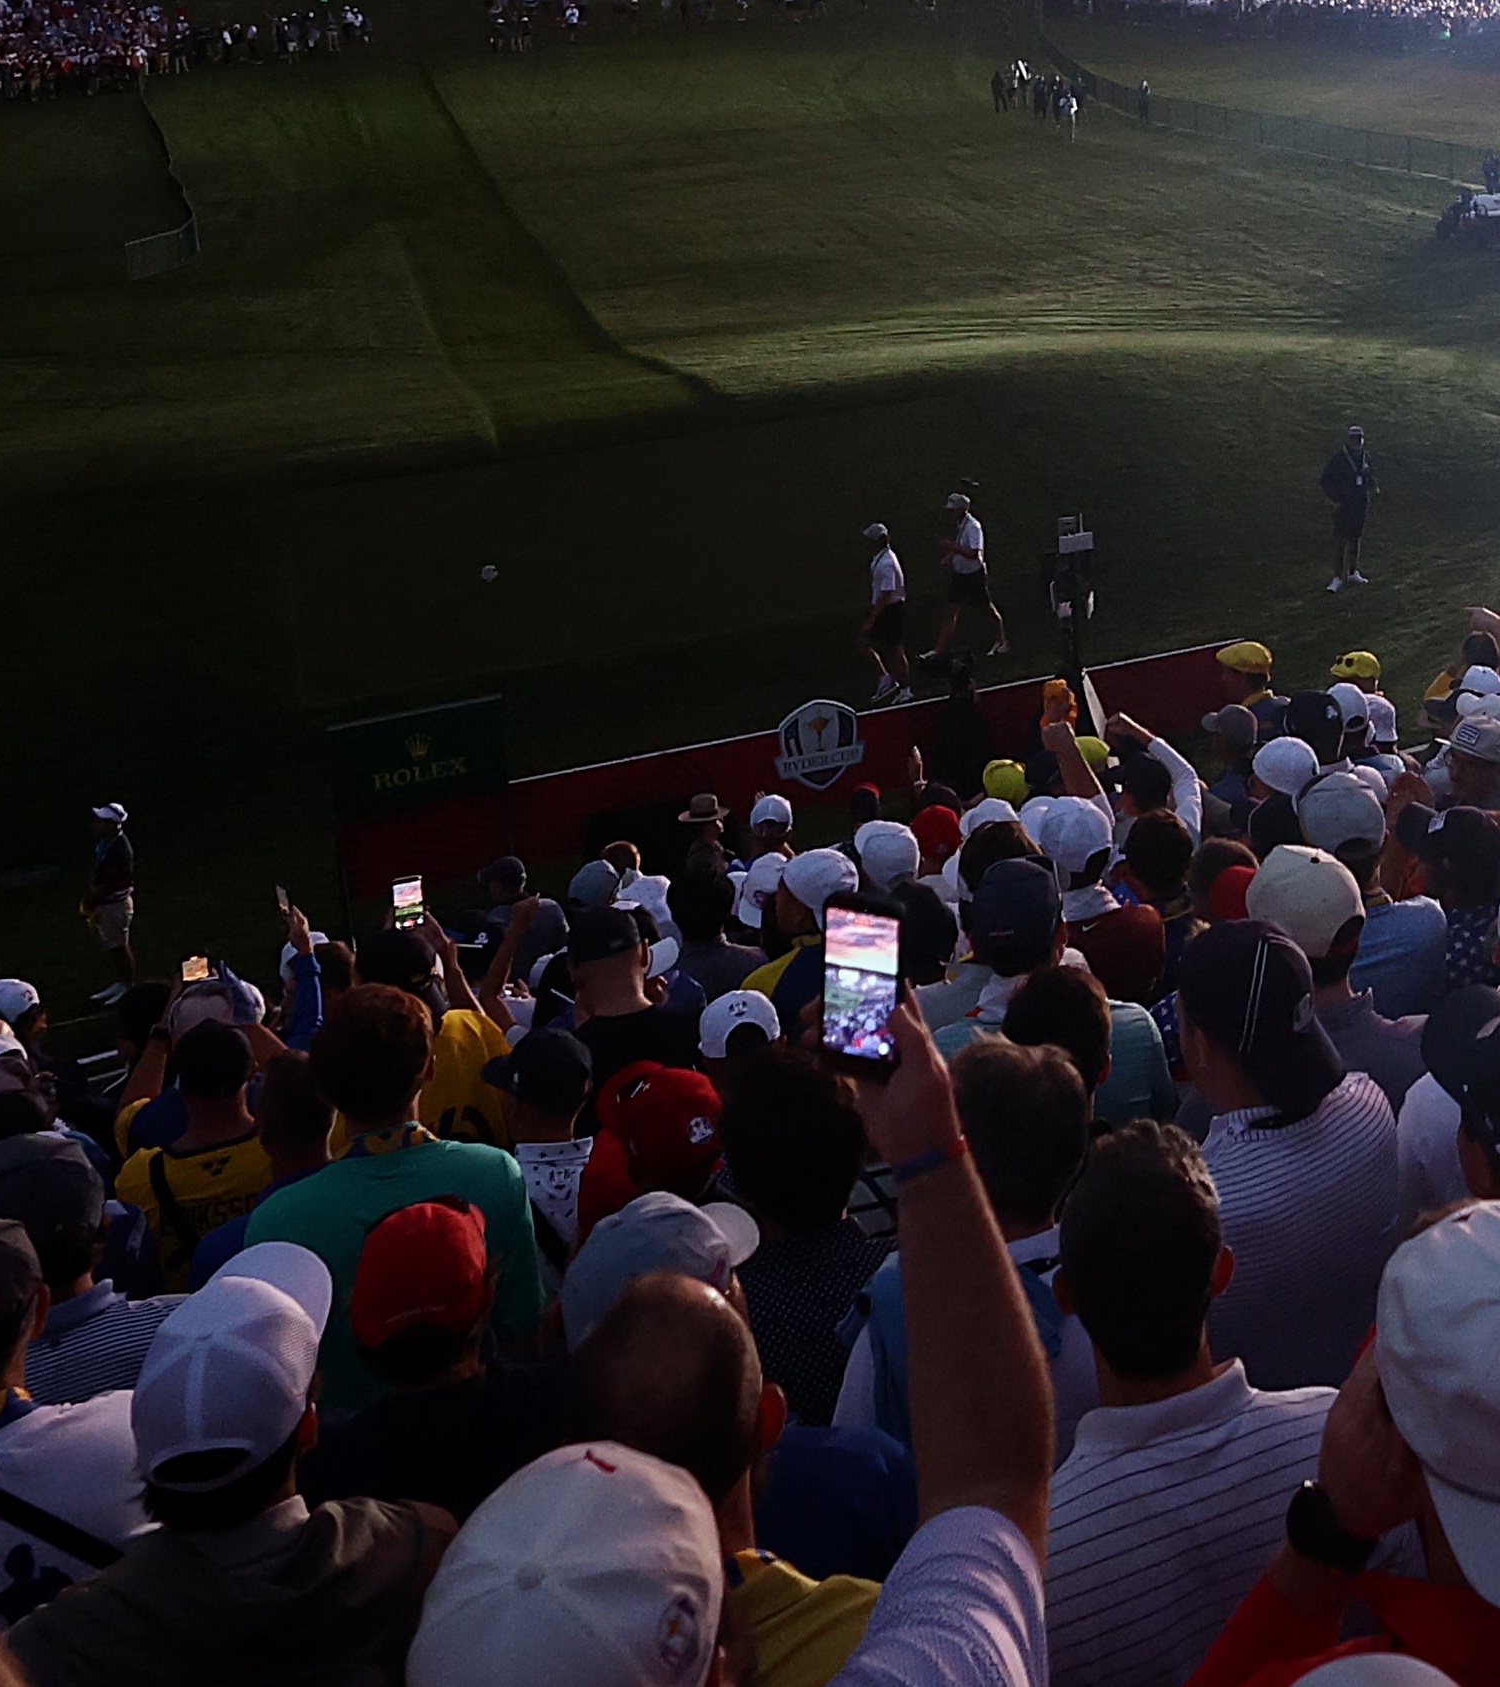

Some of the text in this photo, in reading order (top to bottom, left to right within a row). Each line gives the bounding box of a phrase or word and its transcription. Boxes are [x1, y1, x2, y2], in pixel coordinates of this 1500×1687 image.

[371, 756, 469, 792] ROLEX
[783, 747, 859, 773] RYDER CUP
